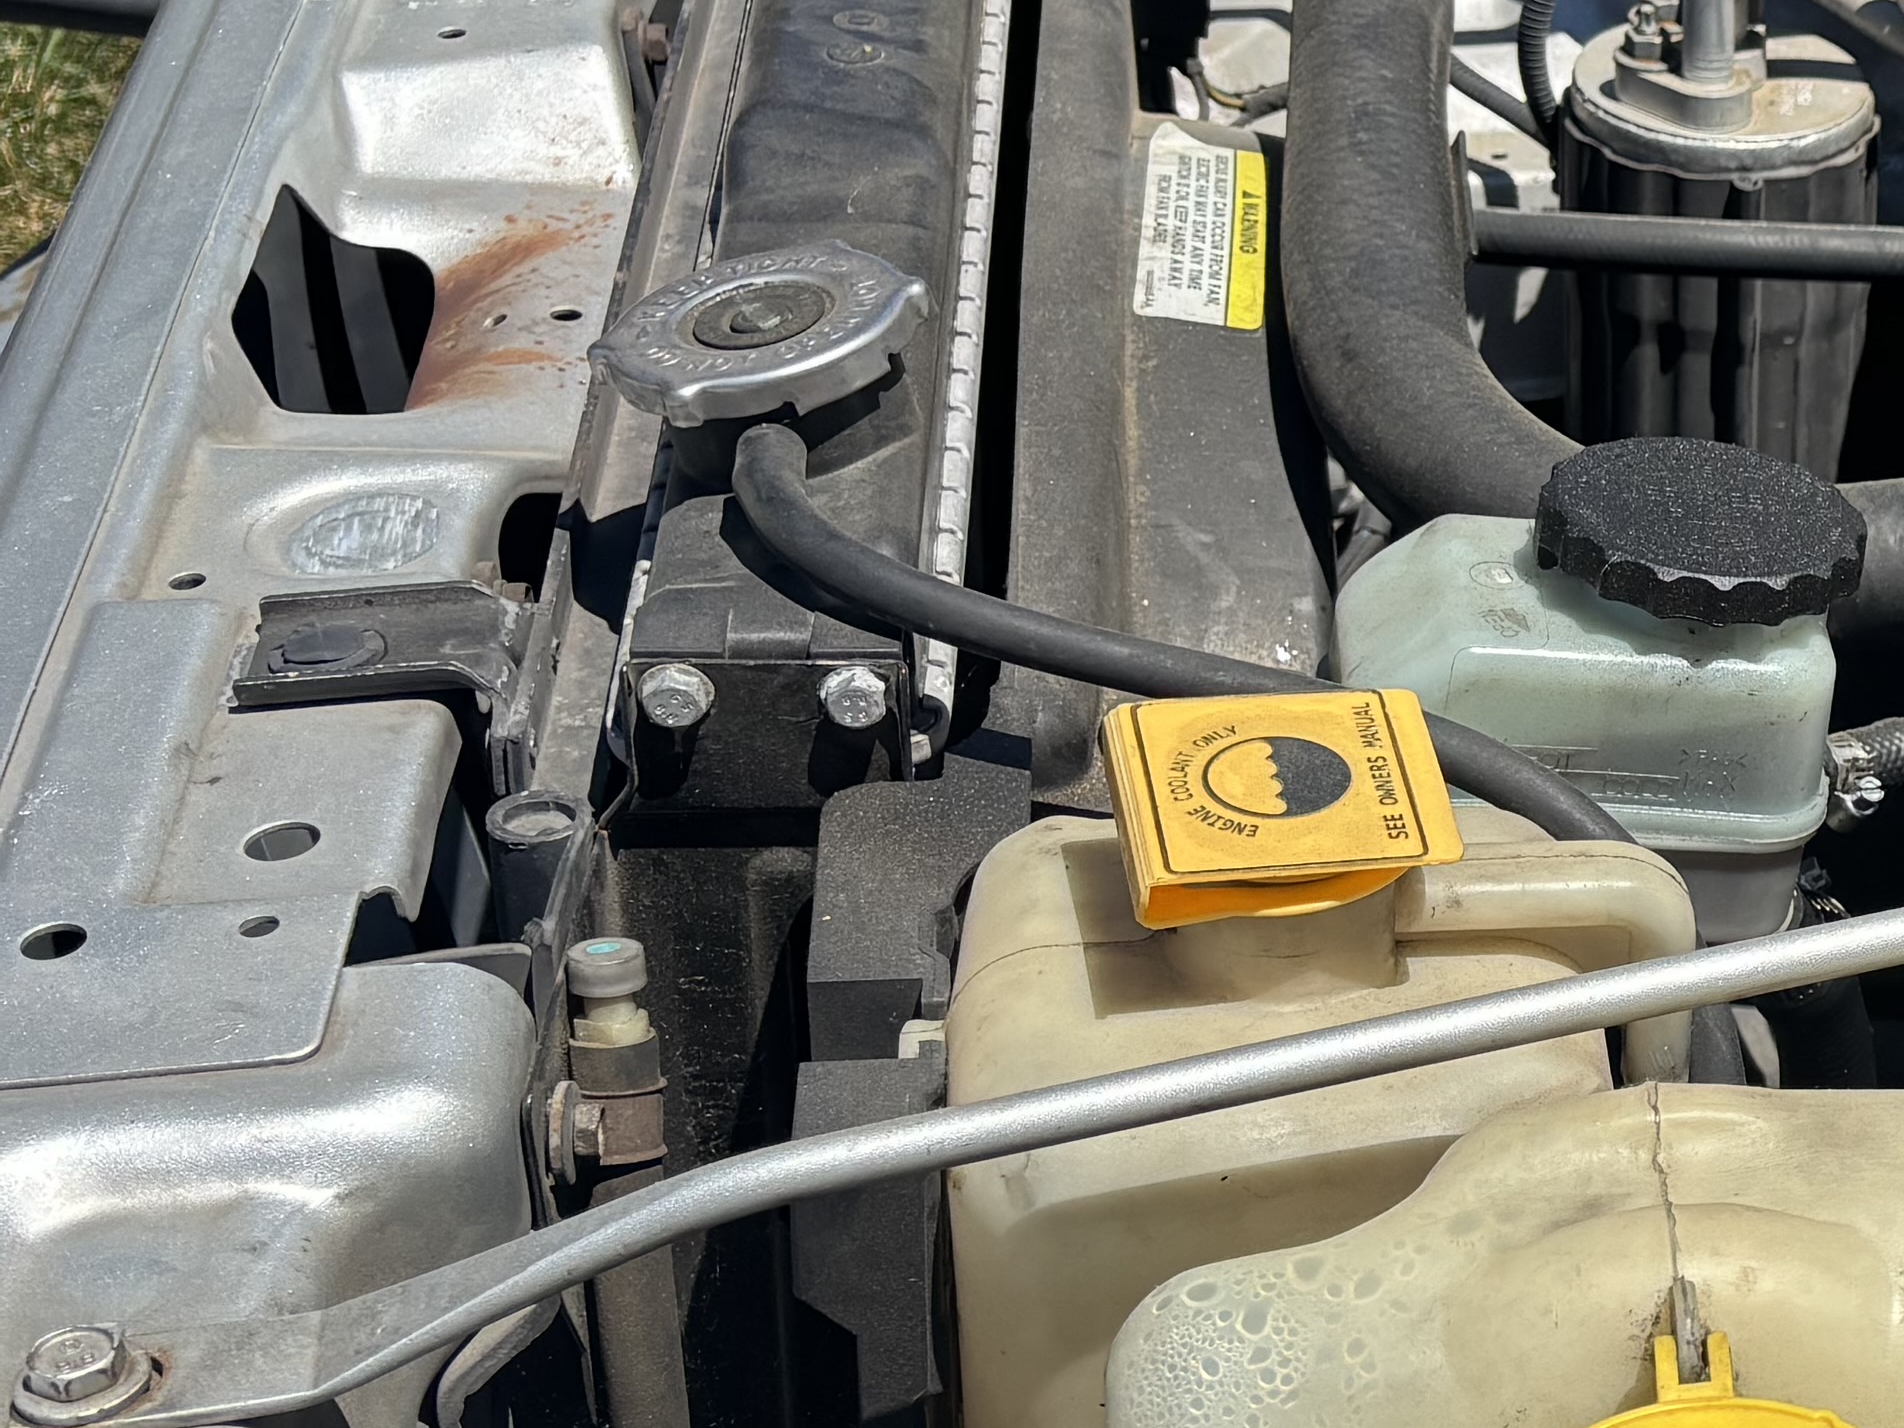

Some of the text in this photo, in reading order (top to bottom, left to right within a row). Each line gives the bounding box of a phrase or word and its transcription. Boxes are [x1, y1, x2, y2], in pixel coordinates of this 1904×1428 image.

[1189, 246, 1205, 266] ANY
[1208, 252, 1223, 281] FROM
[1168, 257, 1184, 289] AWAY
[1166, 724, 1260, 838] ENGINE COOLANT ONLY
[1352, 701, 1409, 840] SEE OWNERS MANUAL
